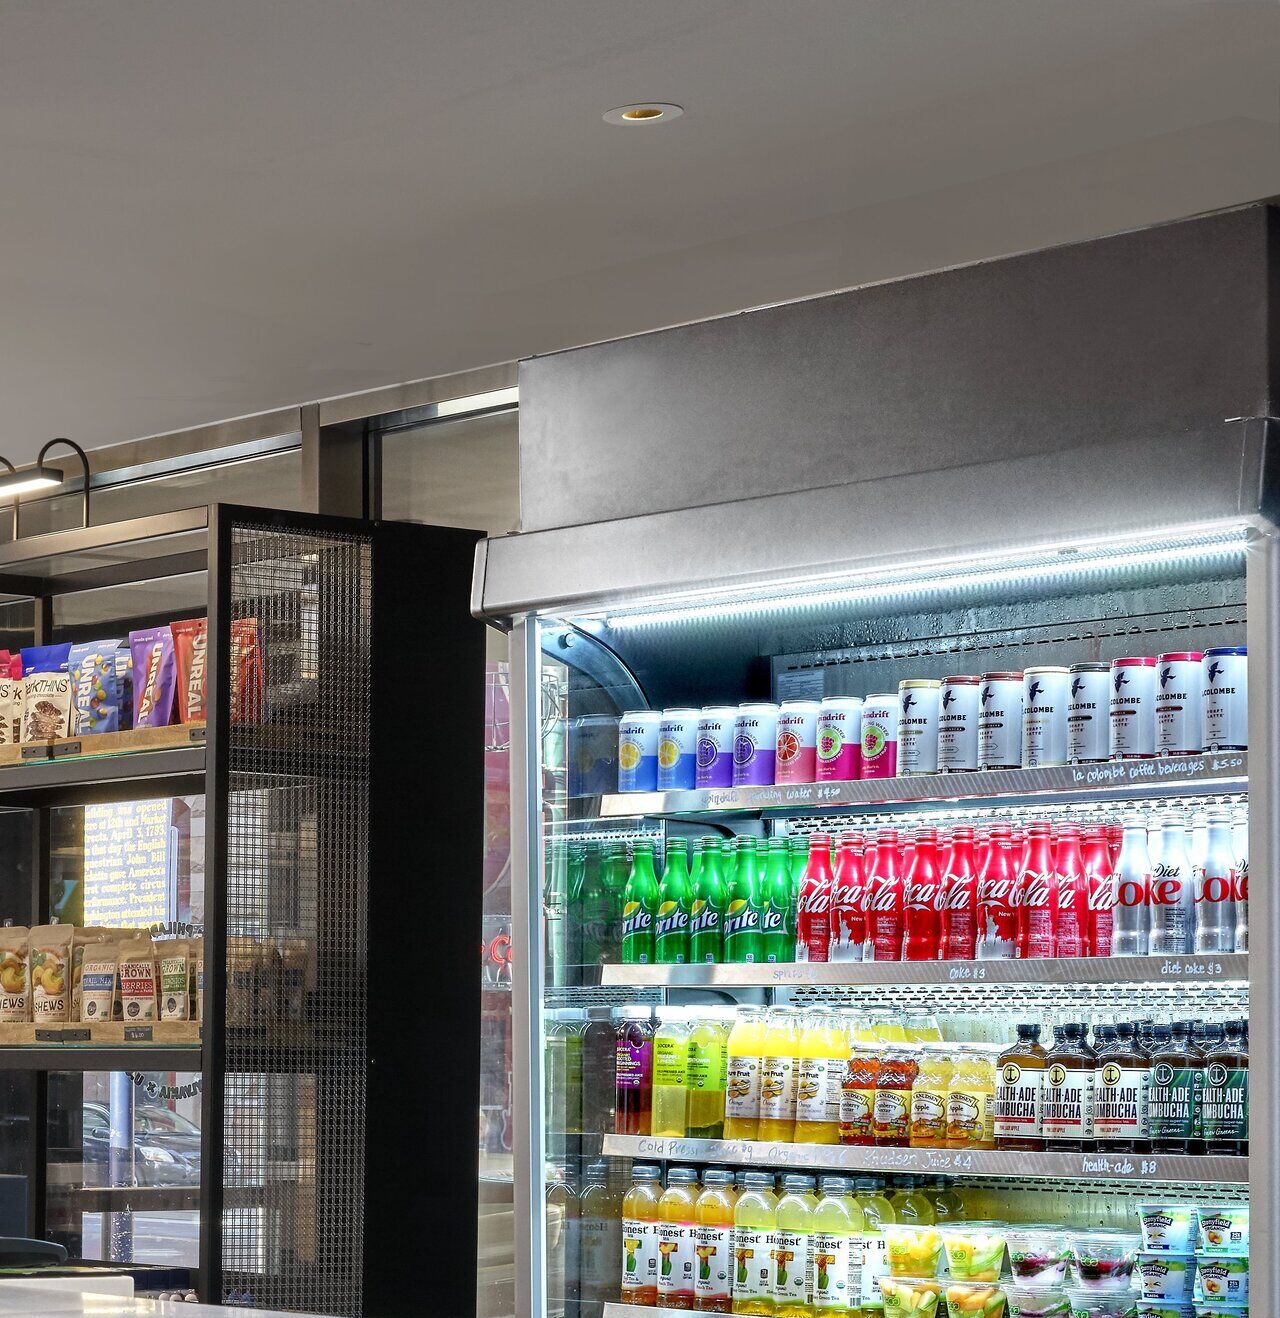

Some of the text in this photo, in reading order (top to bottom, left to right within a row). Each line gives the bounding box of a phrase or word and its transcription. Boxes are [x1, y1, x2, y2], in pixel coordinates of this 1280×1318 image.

[137, 643, 164, 724] UNREAL
[186, 633, 208, 720] UNREAL
[80, 653, 96, 735] UNREAL
[1073, 758, 1243, 783] la colombe coffee beverages $5.50
[787, 787, 812, 801] water
[1152, 862, 1181, 878] Diet
[1161, 960, 1223, 975] diet coke $3
[913, 1103, 930, 1112] Apple
[639, 1139, 664, 1155] Cold
[922, 1151, 952, 1169] Juice
[953, 1155, 972, 1170] $4
[1082, 1157, 1157, 1174] health-ade $8
